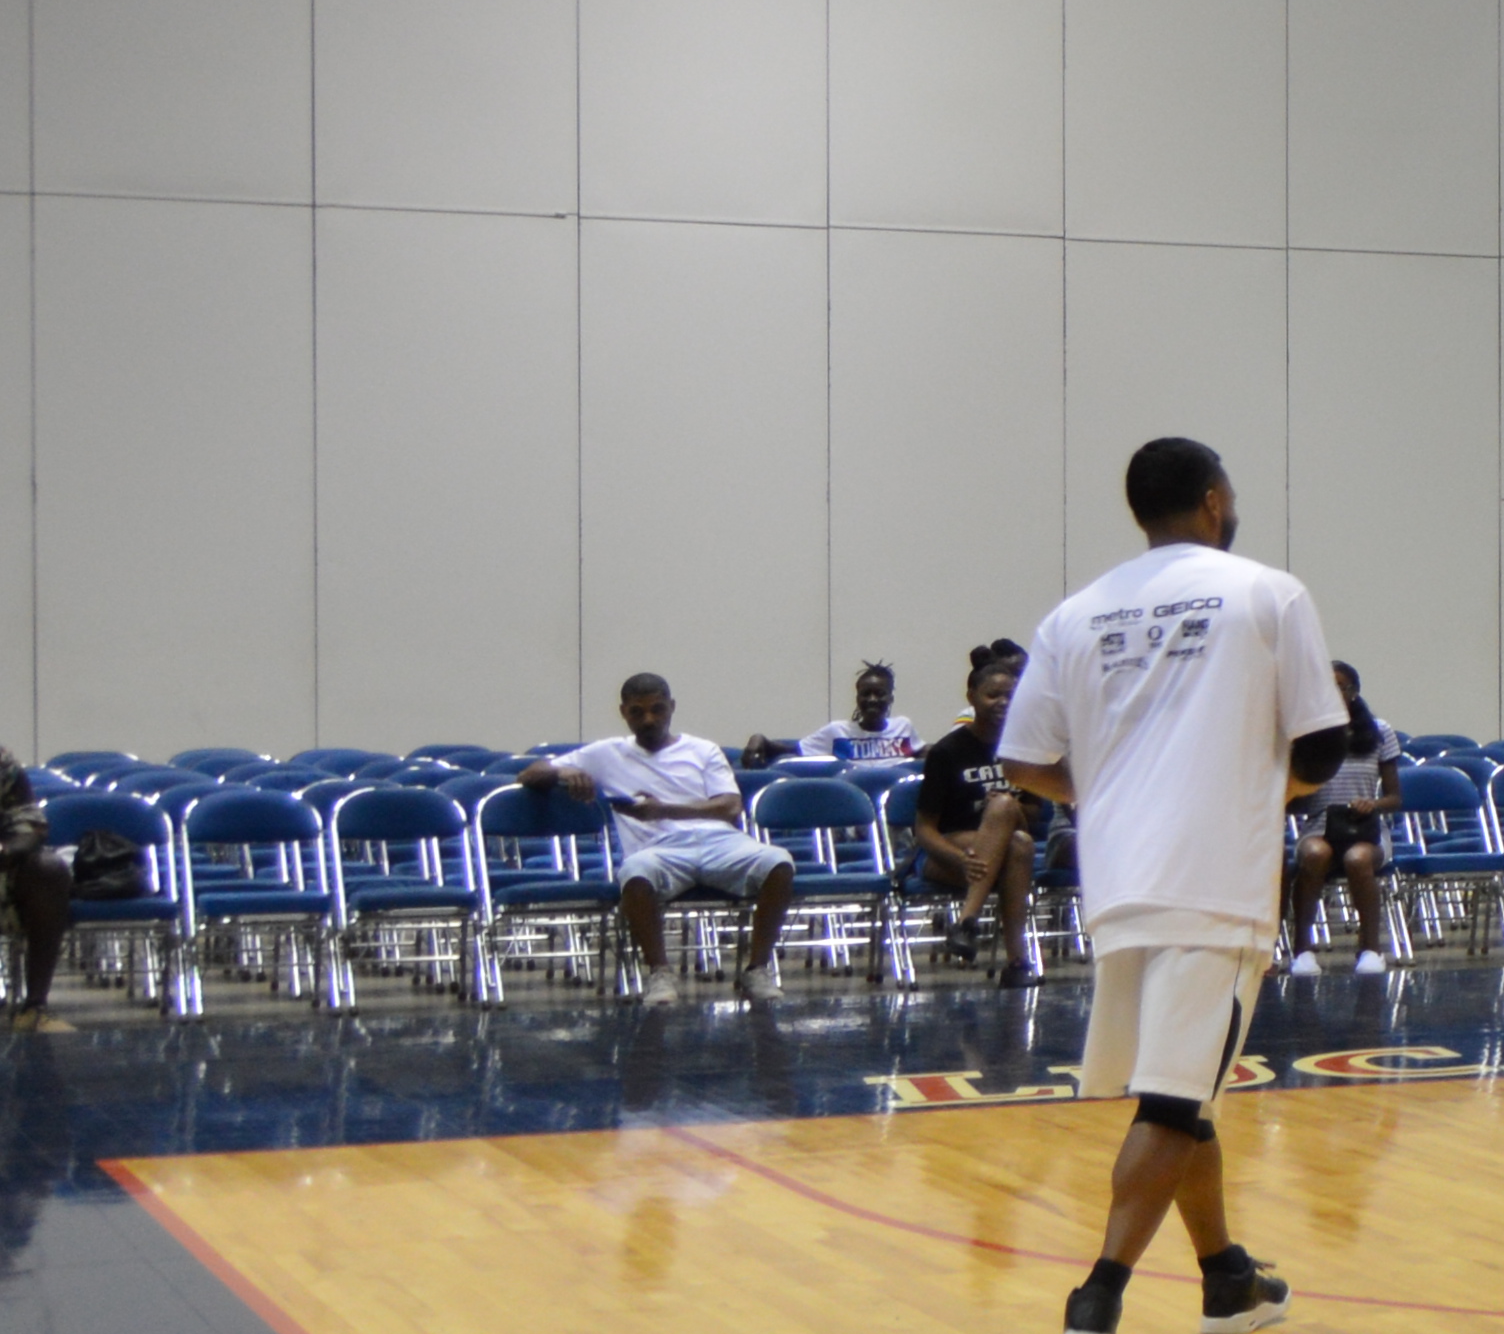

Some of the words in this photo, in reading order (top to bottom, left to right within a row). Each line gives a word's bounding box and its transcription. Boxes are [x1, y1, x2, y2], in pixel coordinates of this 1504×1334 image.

[1091, 608, 1143, 625] metro
[1153, 597, 1223, 618] GEICO
[850, 738, 905, 759] TOMMY
